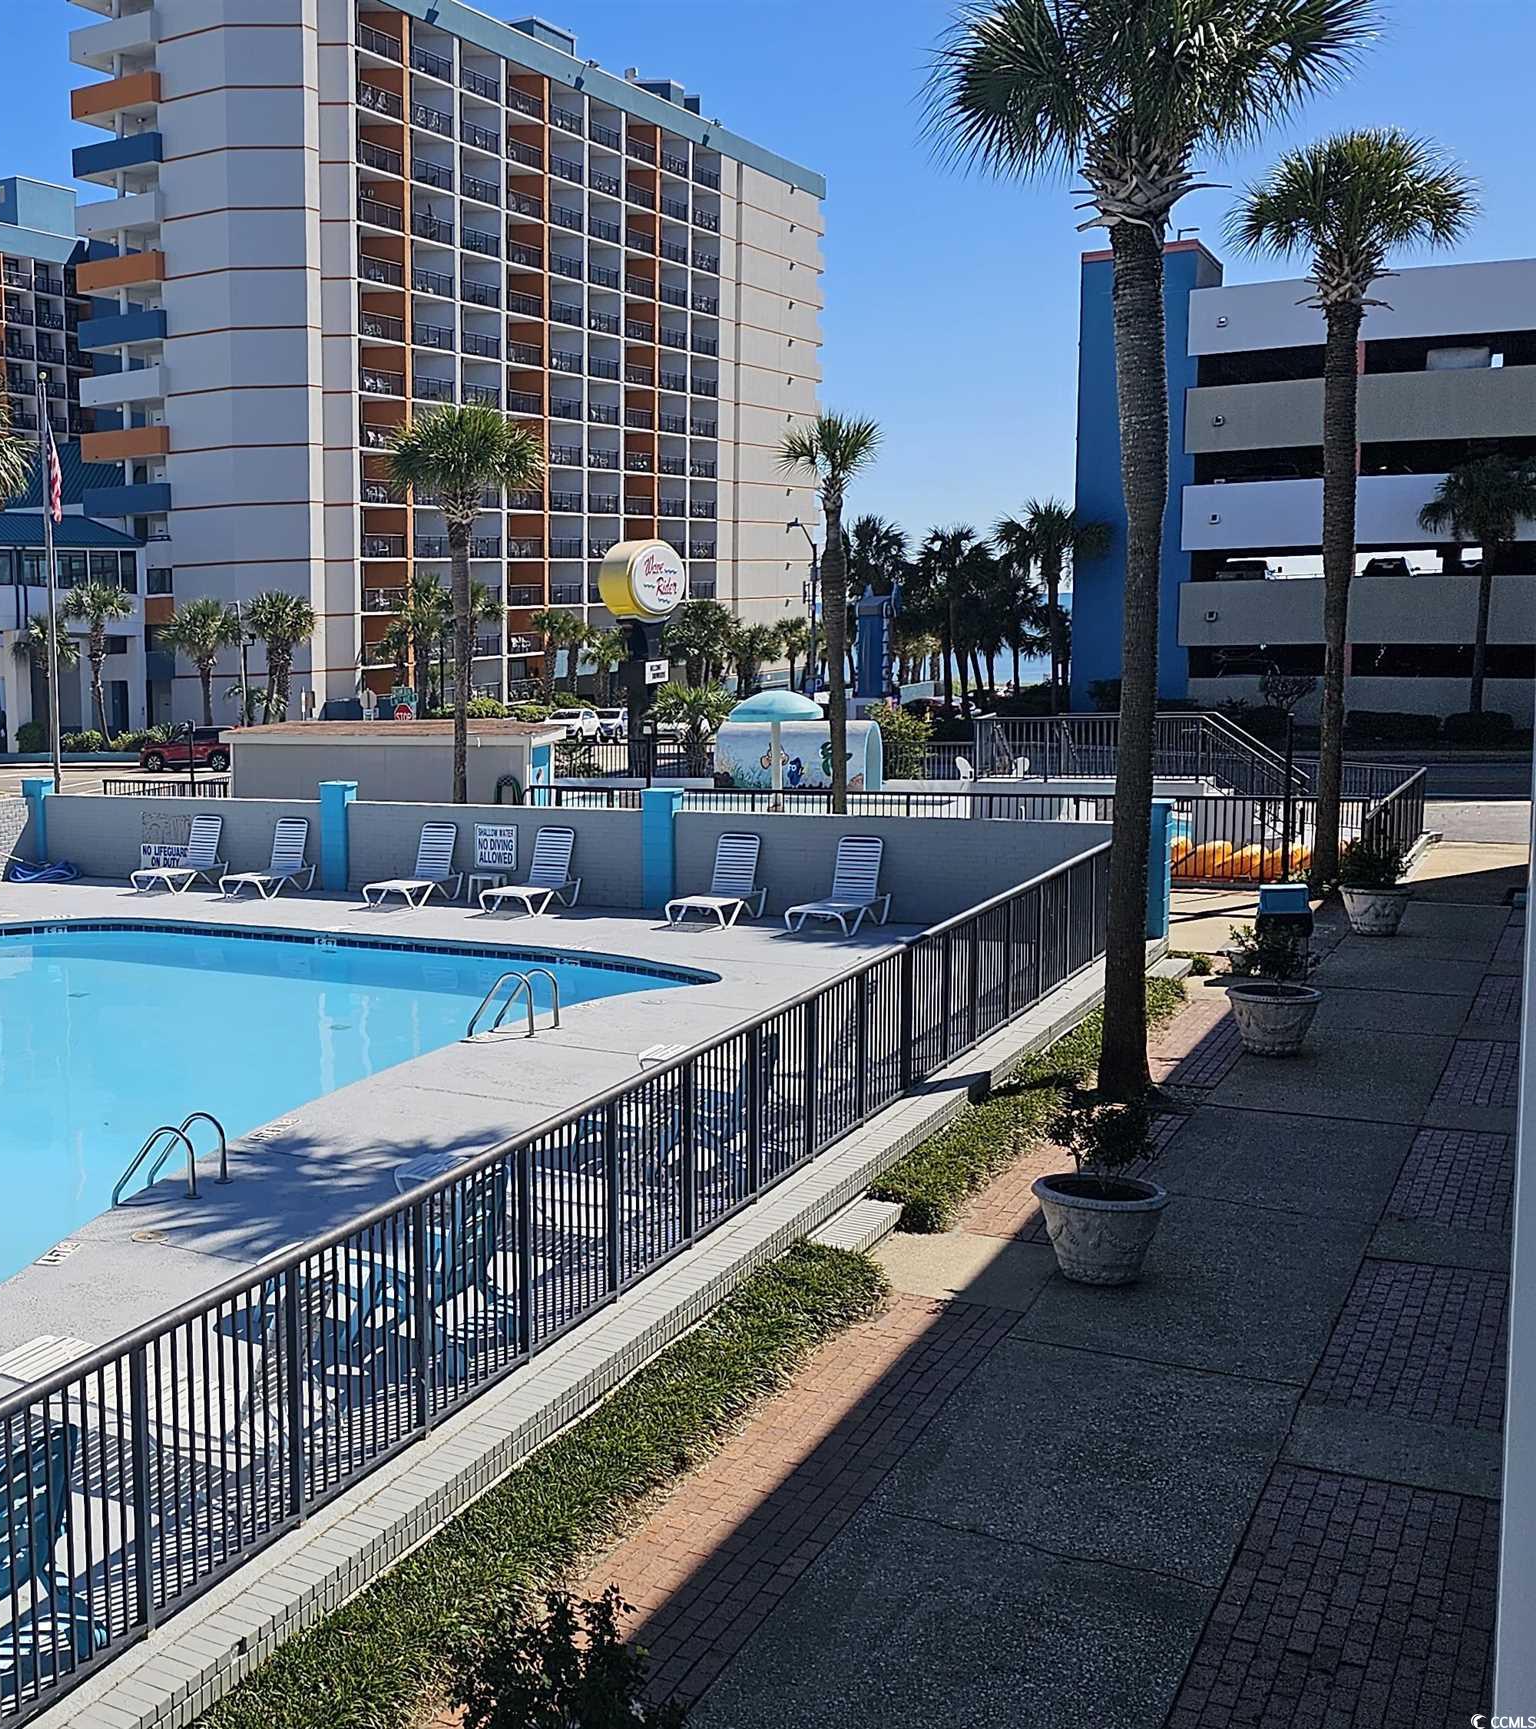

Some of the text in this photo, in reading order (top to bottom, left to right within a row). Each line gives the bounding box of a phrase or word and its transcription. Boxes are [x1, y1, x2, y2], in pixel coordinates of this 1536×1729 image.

[655, 576, 677, 597] Rider
[396, 712, 413, 721] STOP
[143, 845, 152, 856] NO
[478, 838, 514, 851] NO DIVING
[151, 856, 181, 868] ON DUTY
[478, 851, 513, 865] ALLOWED
